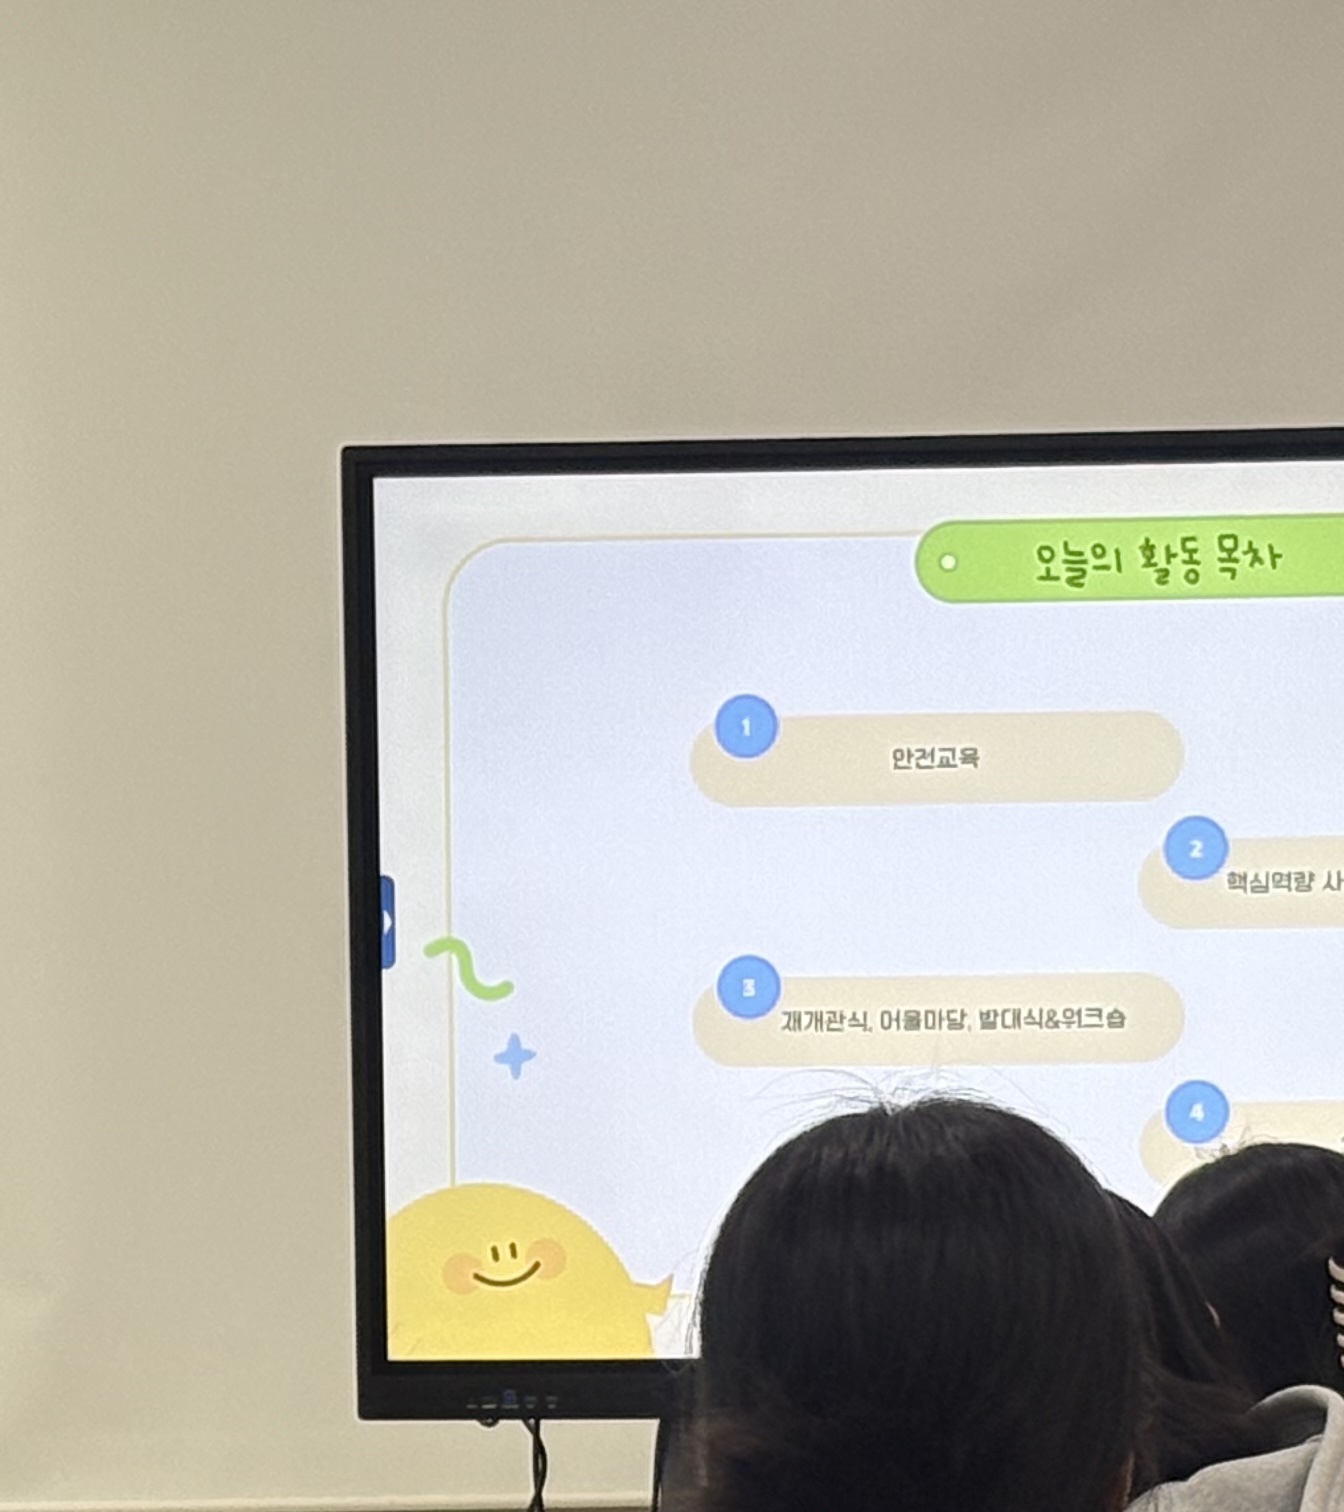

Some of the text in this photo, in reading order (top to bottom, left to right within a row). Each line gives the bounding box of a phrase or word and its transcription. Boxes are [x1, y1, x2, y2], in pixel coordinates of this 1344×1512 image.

[1036, 533, 1283, 589] 오늘의 활동 목차
[741, 717, 751, 737] 1
[891, 746, 981, 771] 안전교육
[1188, 840, 1204, 859] 2
[1227, 870, 1316, 894] 핵심역량
[742, 978, 755, 997] 3
[781, 1009, 873, 1033] 재개관식,
[879, 1008, 972, 1033] 어울마당,
[1189, 1103, 1204, 1122] 4
